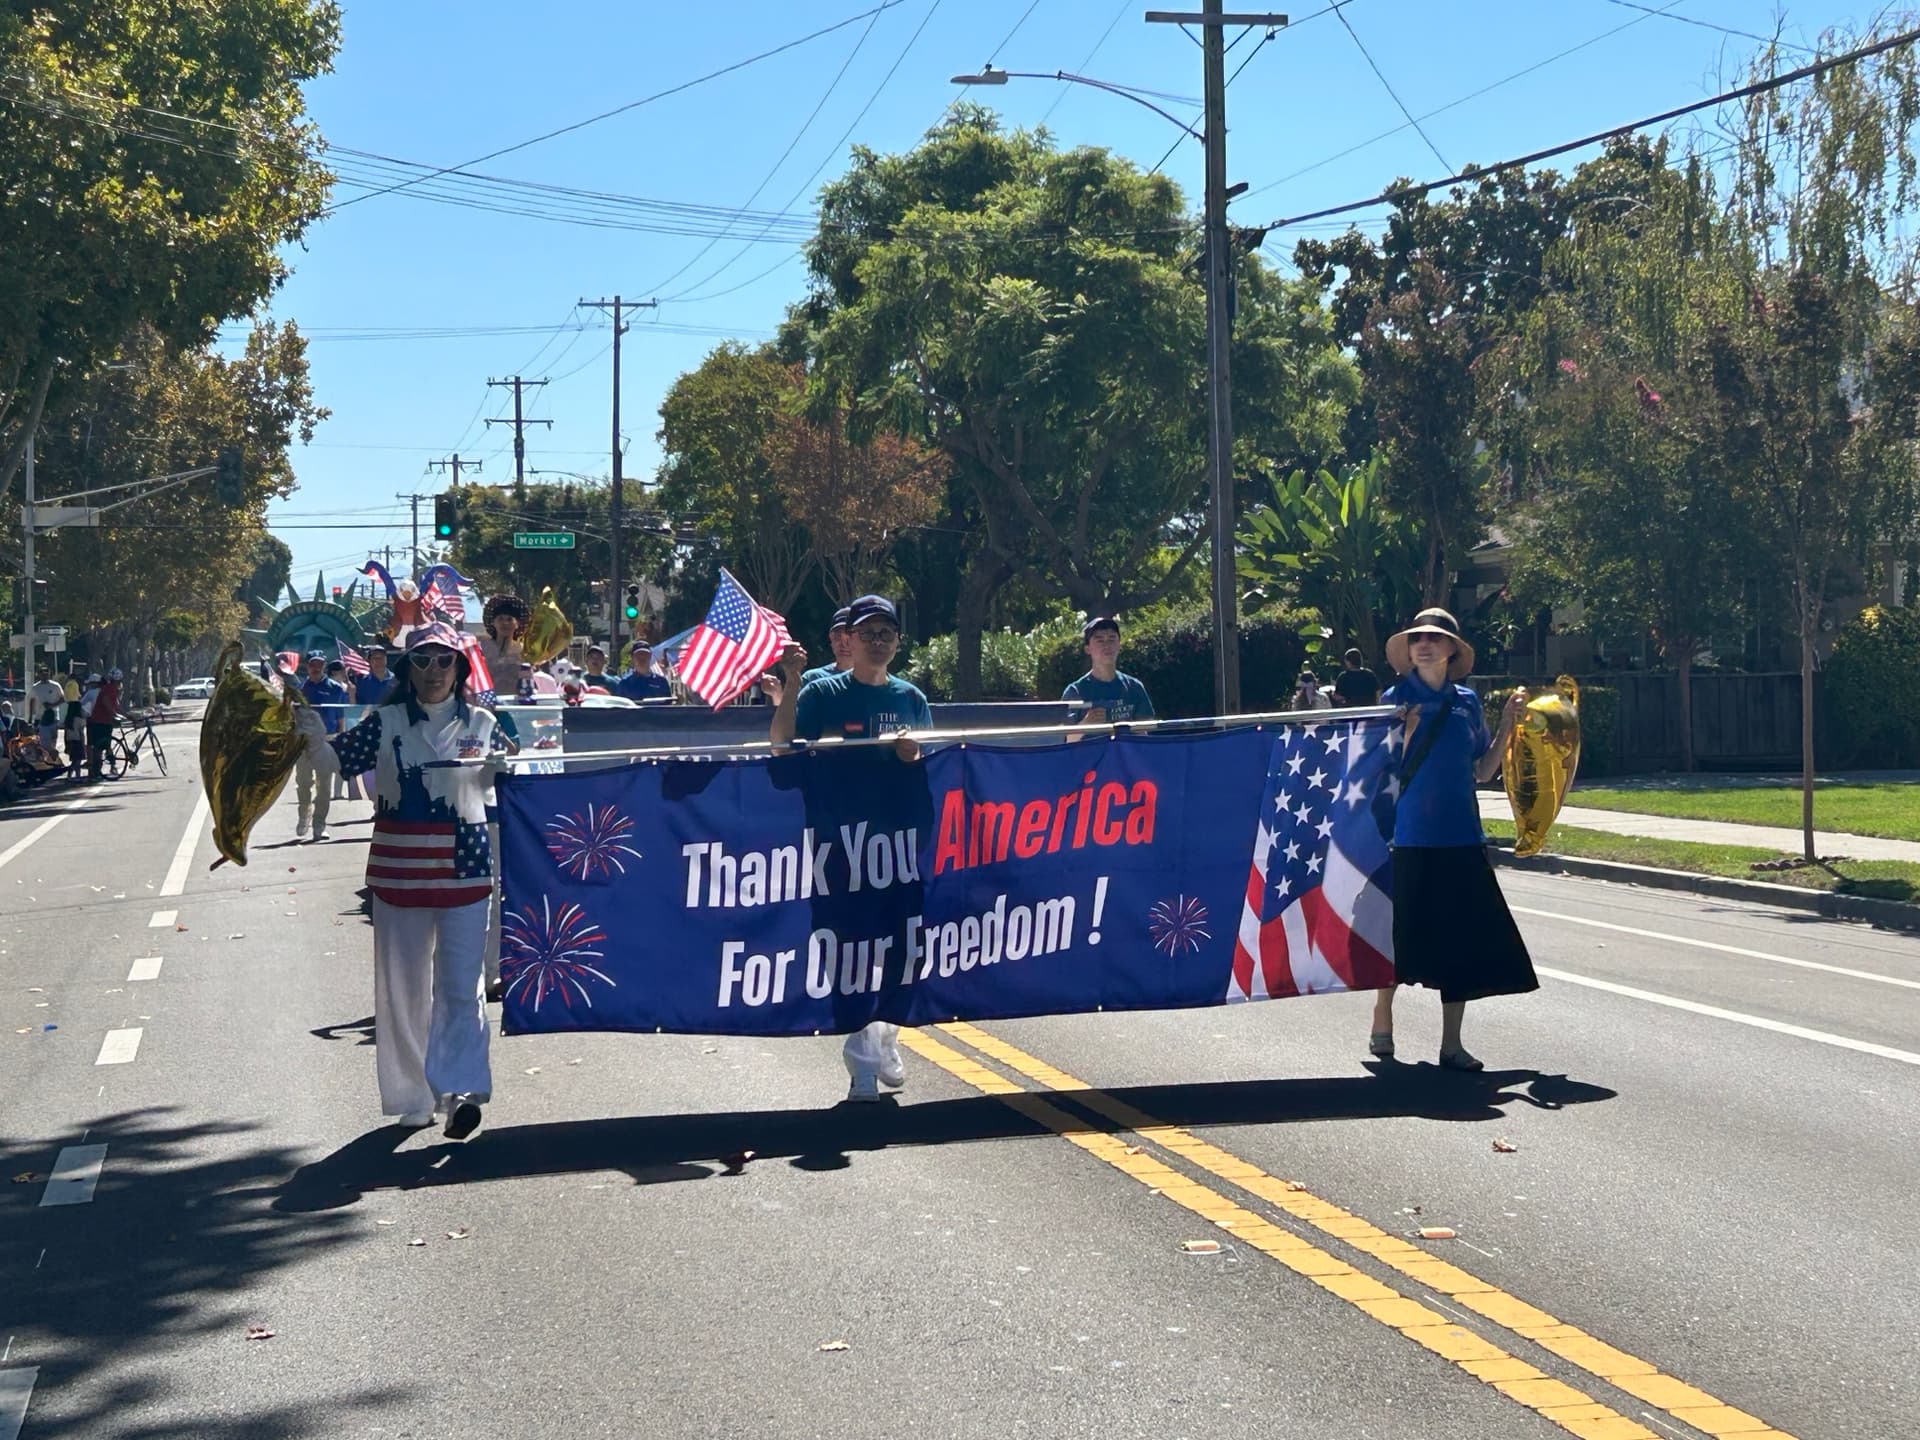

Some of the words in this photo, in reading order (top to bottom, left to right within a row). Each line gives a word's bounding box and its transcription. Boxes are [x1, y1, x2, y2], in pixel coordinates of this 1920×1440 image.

[519, 536, 557, 545] Market
[877, 712, 898, 722] THE
[682, 827, 833, 908] Thank
[839, 820, 920, 892] You
[934, 770, 1158, 876] America
[717, 941, 796, 1008] For
[805, 928, 894, 1000] Our
[900, 894, 1076, 985] Freedom
[1087, 876, 1110, 945] !
